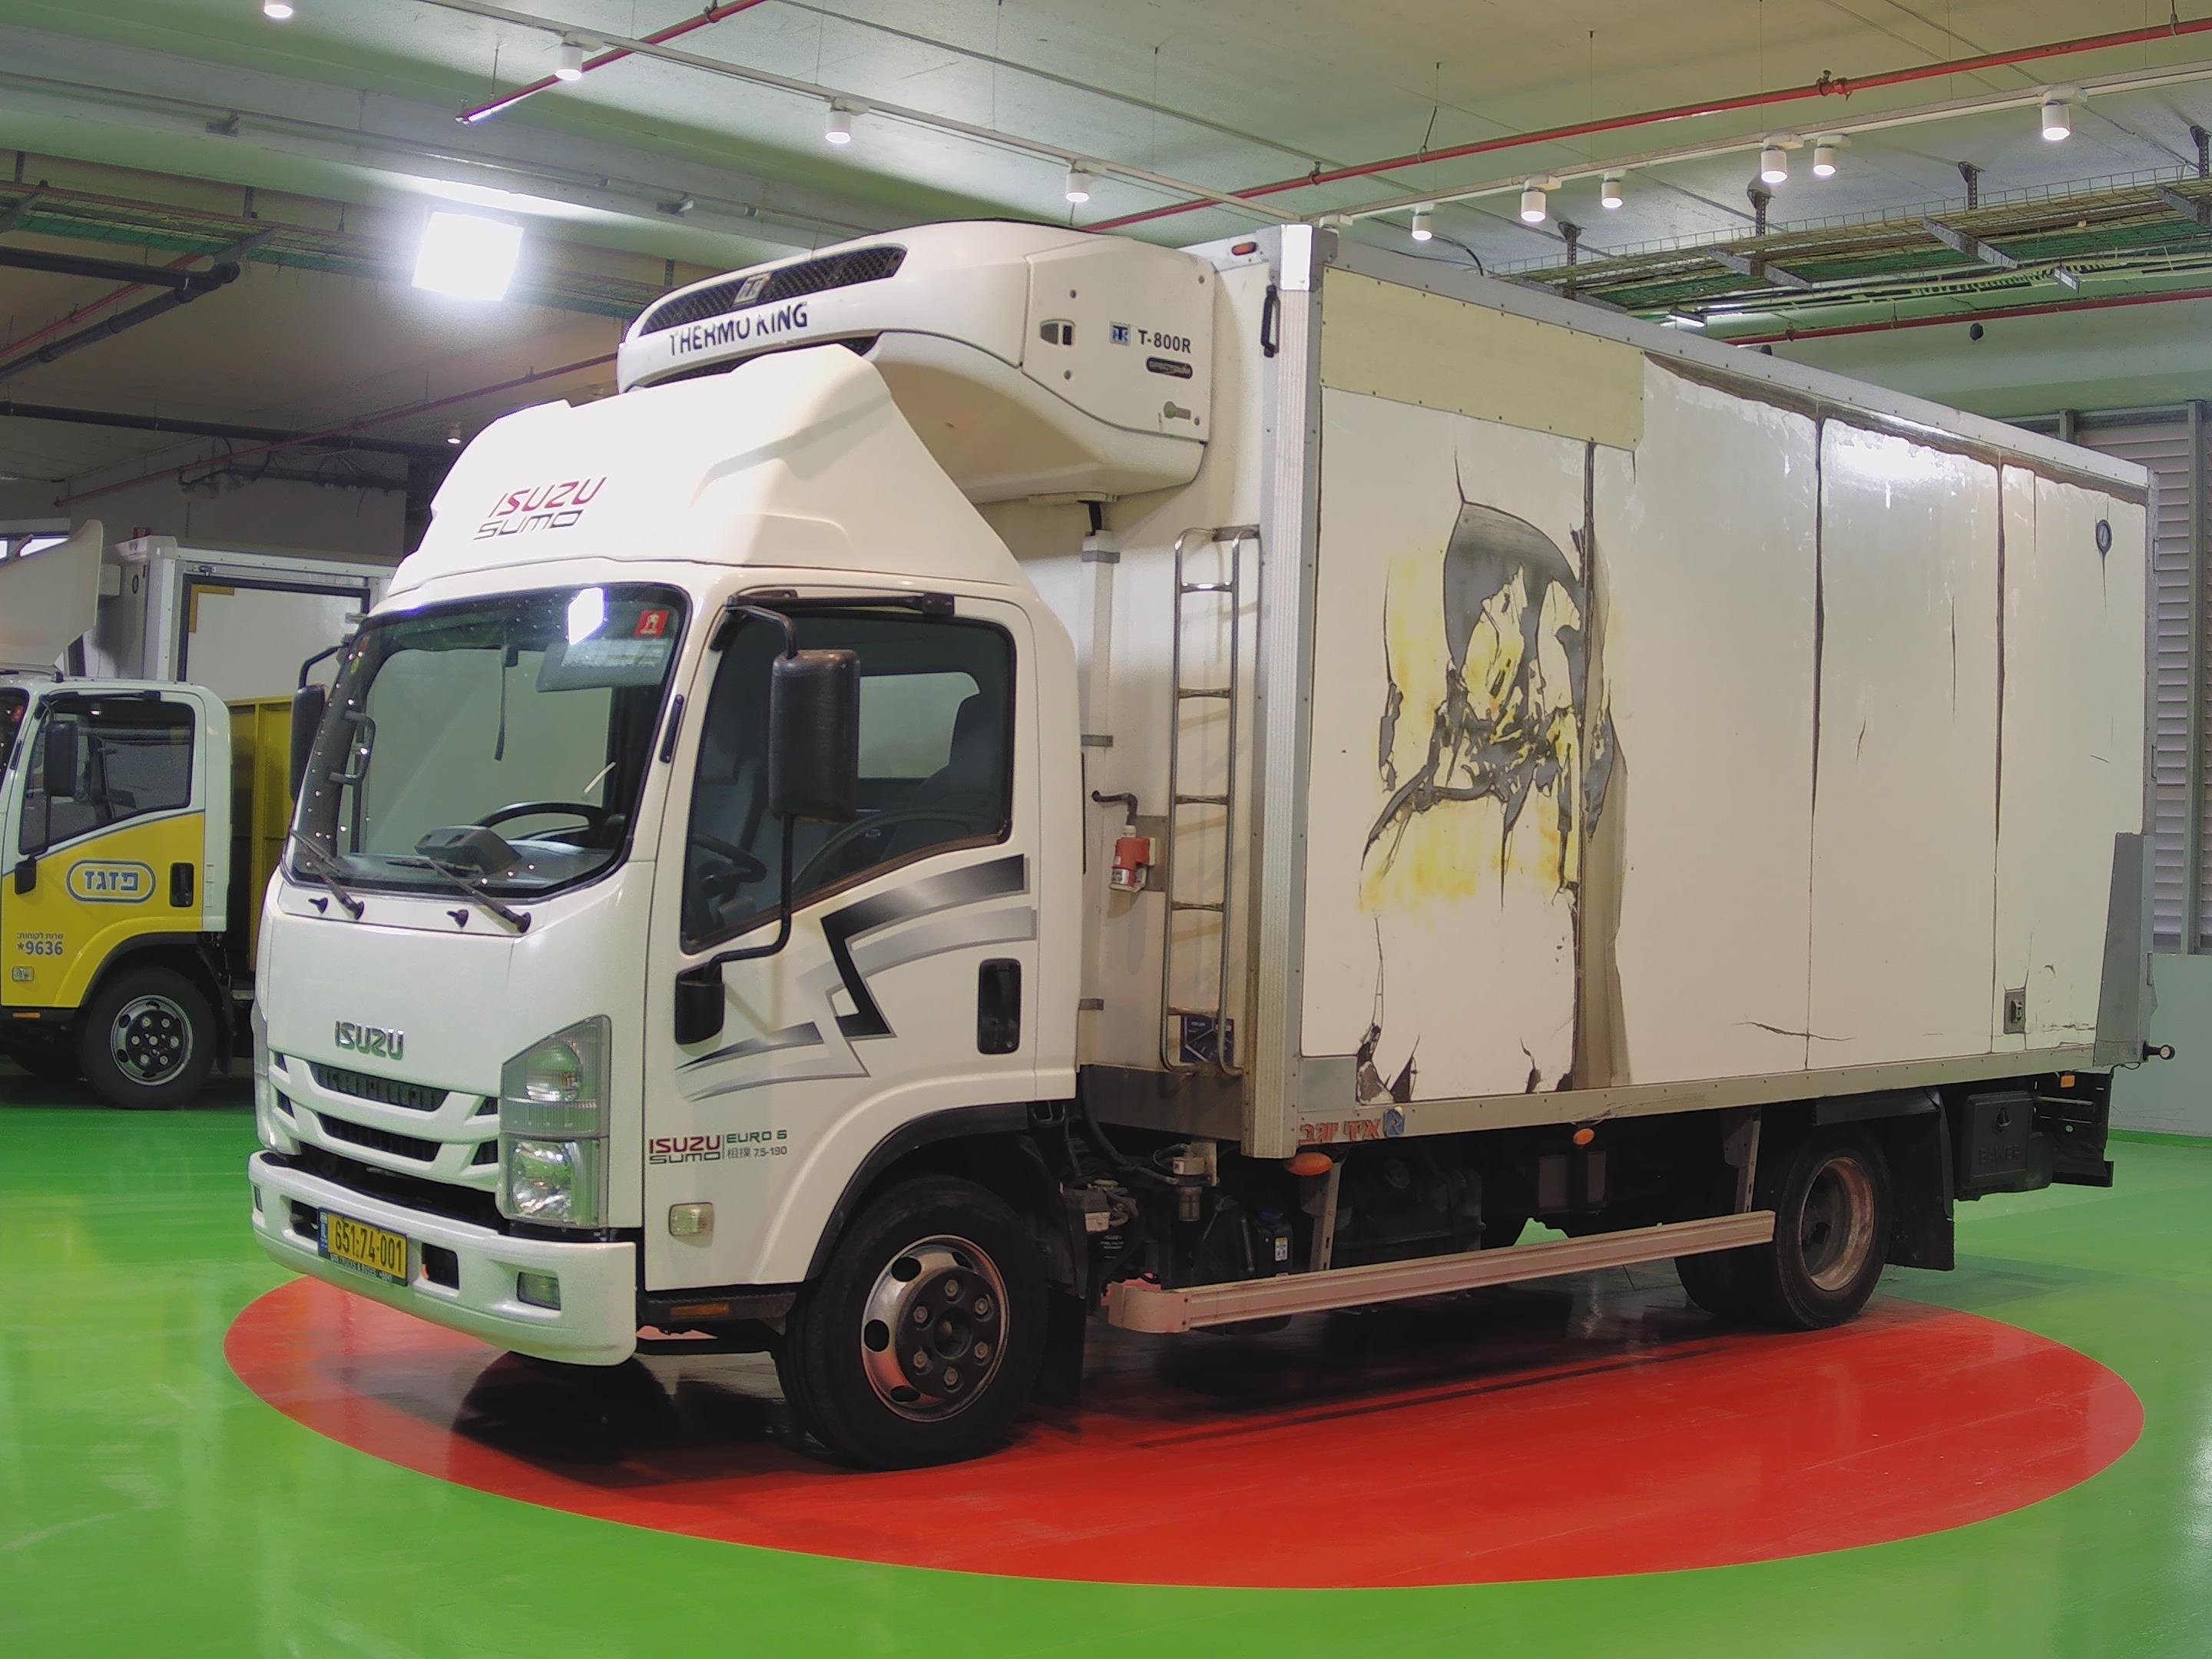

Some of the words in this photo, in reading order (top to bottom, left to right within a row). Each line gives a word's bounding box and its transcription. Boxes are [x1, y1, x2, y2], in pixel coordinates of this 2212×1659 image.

[757, 301, 808, 336] KING
[1137, 328, 1191, 354] T-800R
[488, 476, 608, 518] ISUZU
[473, 509, 584, 540] SUMO
[84, 870, 138, 891] פזגז
[335, 1021, 404, 1061] ISUZU
[649, 1134, 720, 1154] ISUZU
[726, 1131, 772, 1144] EURO
[649, 1151, 720, 1165] SUMO
